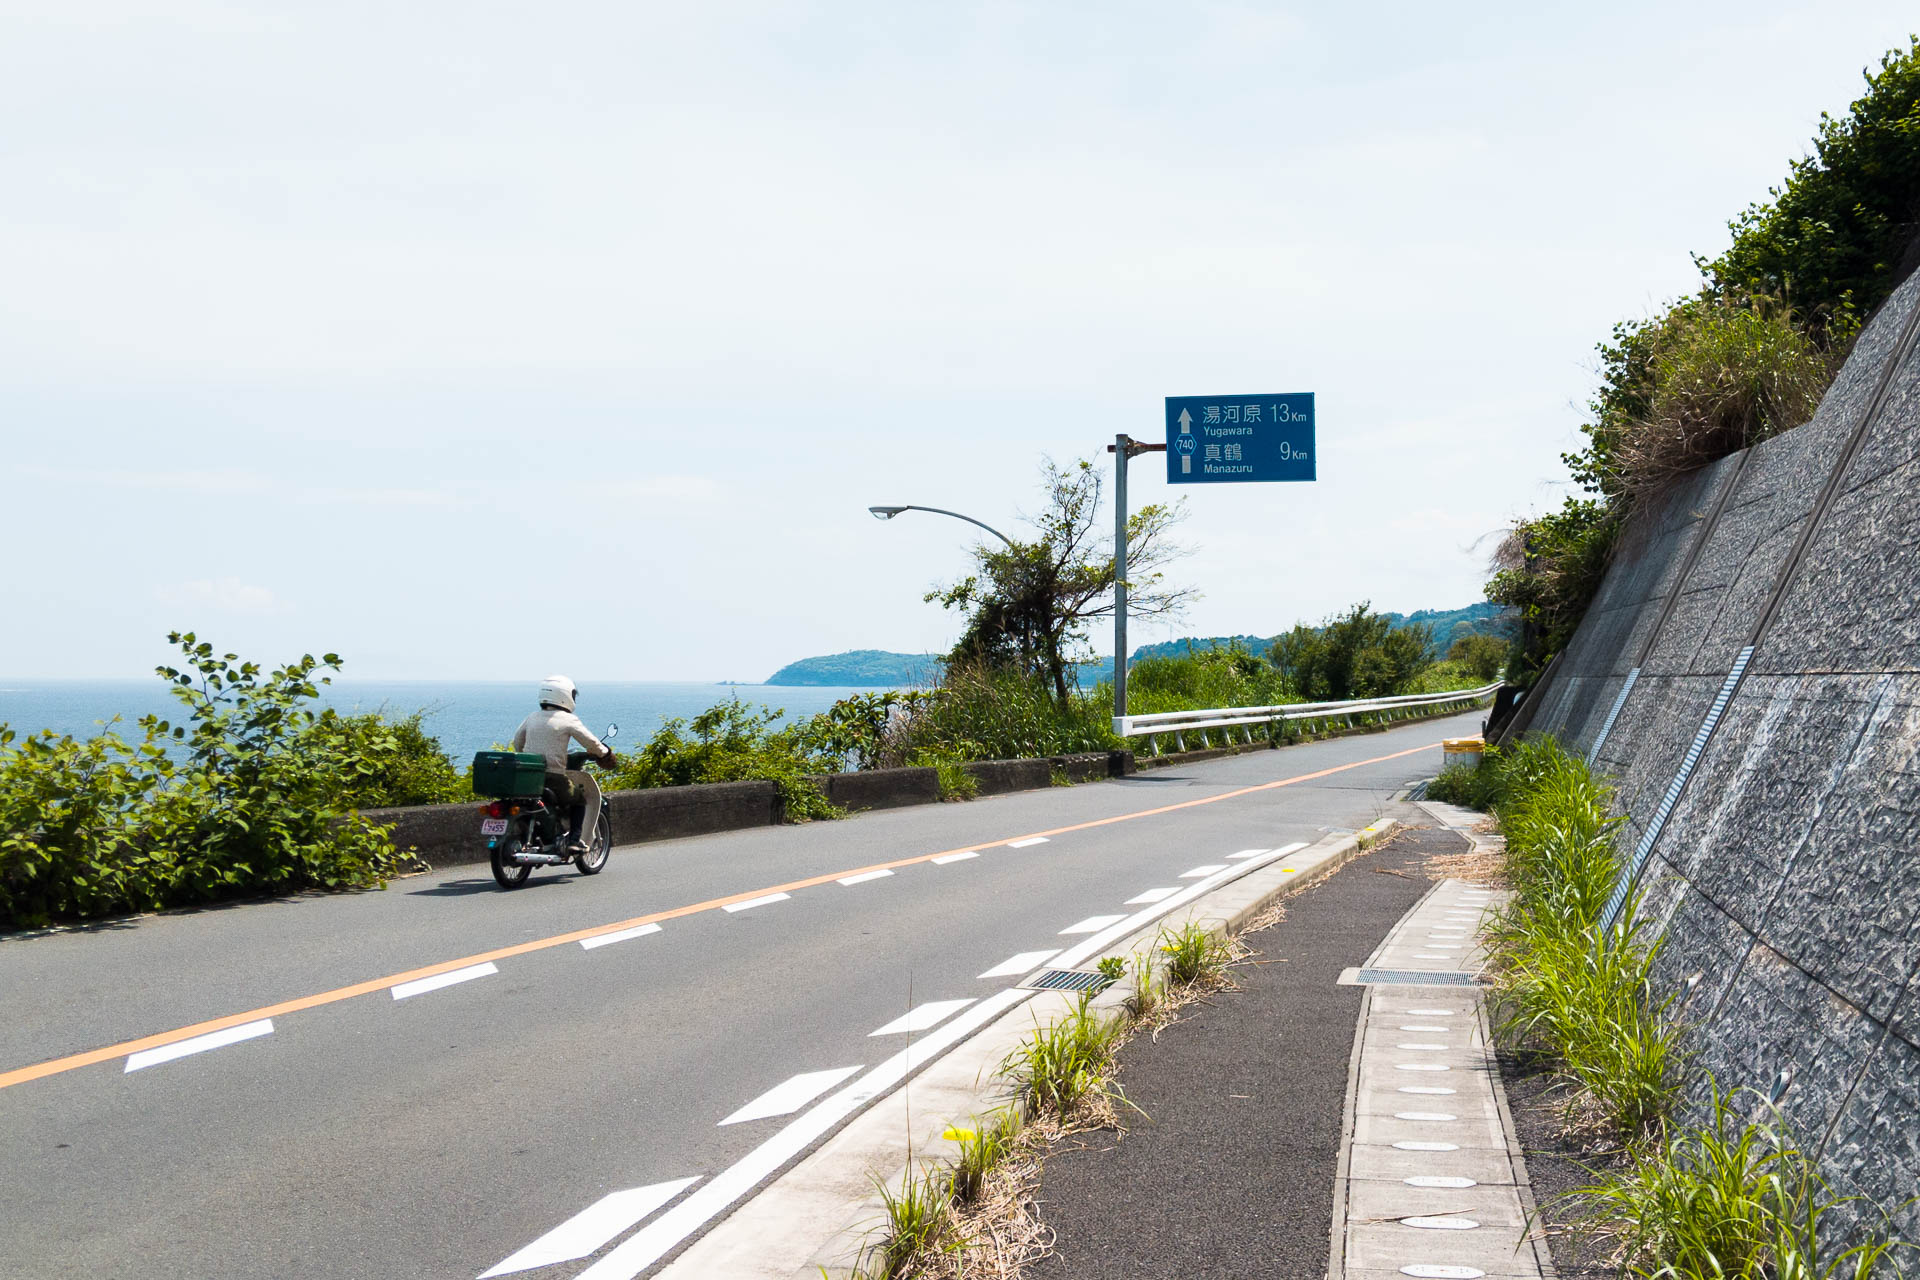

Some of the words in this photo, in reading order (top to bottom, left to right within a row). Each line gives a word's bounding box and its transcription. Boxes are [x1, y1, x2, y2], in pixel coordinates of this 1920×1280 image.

[1203, 405, 1261, 423] 湯河原
[1203, 426, 1253, 437] Yugawara
[1178, 439, 1194, 450] 740
[1203, 443, 1242, 461] 真鶴
[1203, 464, 1253, 473] Manazuru
